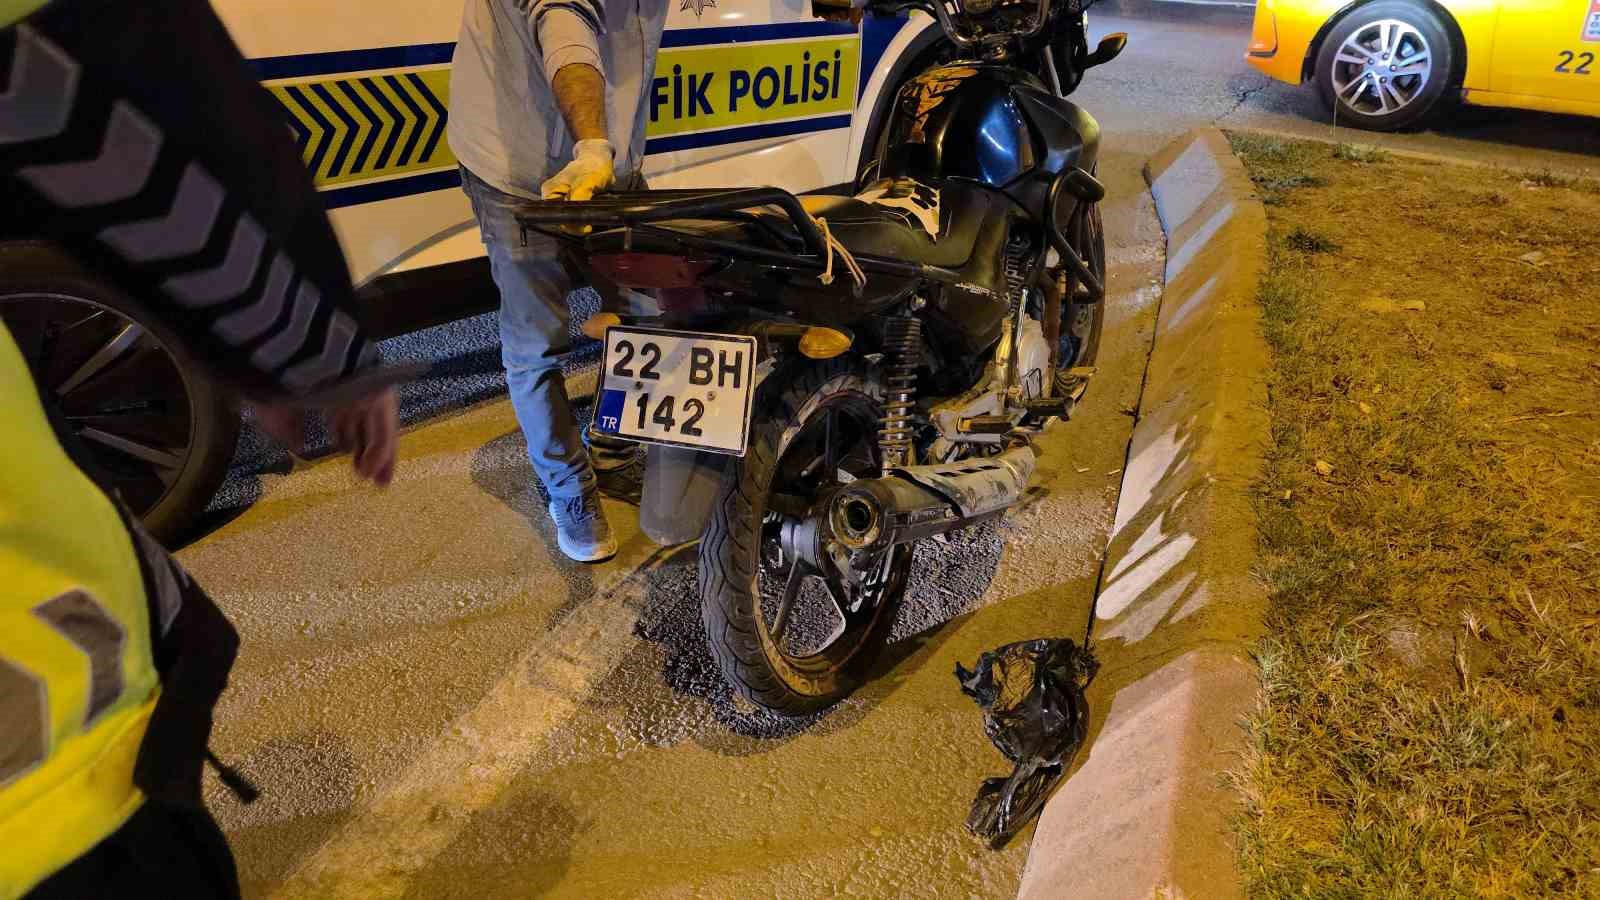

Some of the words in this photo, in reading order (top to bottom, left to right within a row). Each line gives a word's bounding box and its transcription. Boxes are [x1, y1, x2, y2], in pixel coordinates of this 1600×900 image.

[1554, 50, 1594, 75] 22
[650, 63, 714, 122] FİK
[729, 49, 841, 113] POLİSİ
[613, 339, 662, 380] 22
[689, 346, 743, 388] BH
[602, 415, 618, 430] TR
[636, 393, 705, 437] 142
